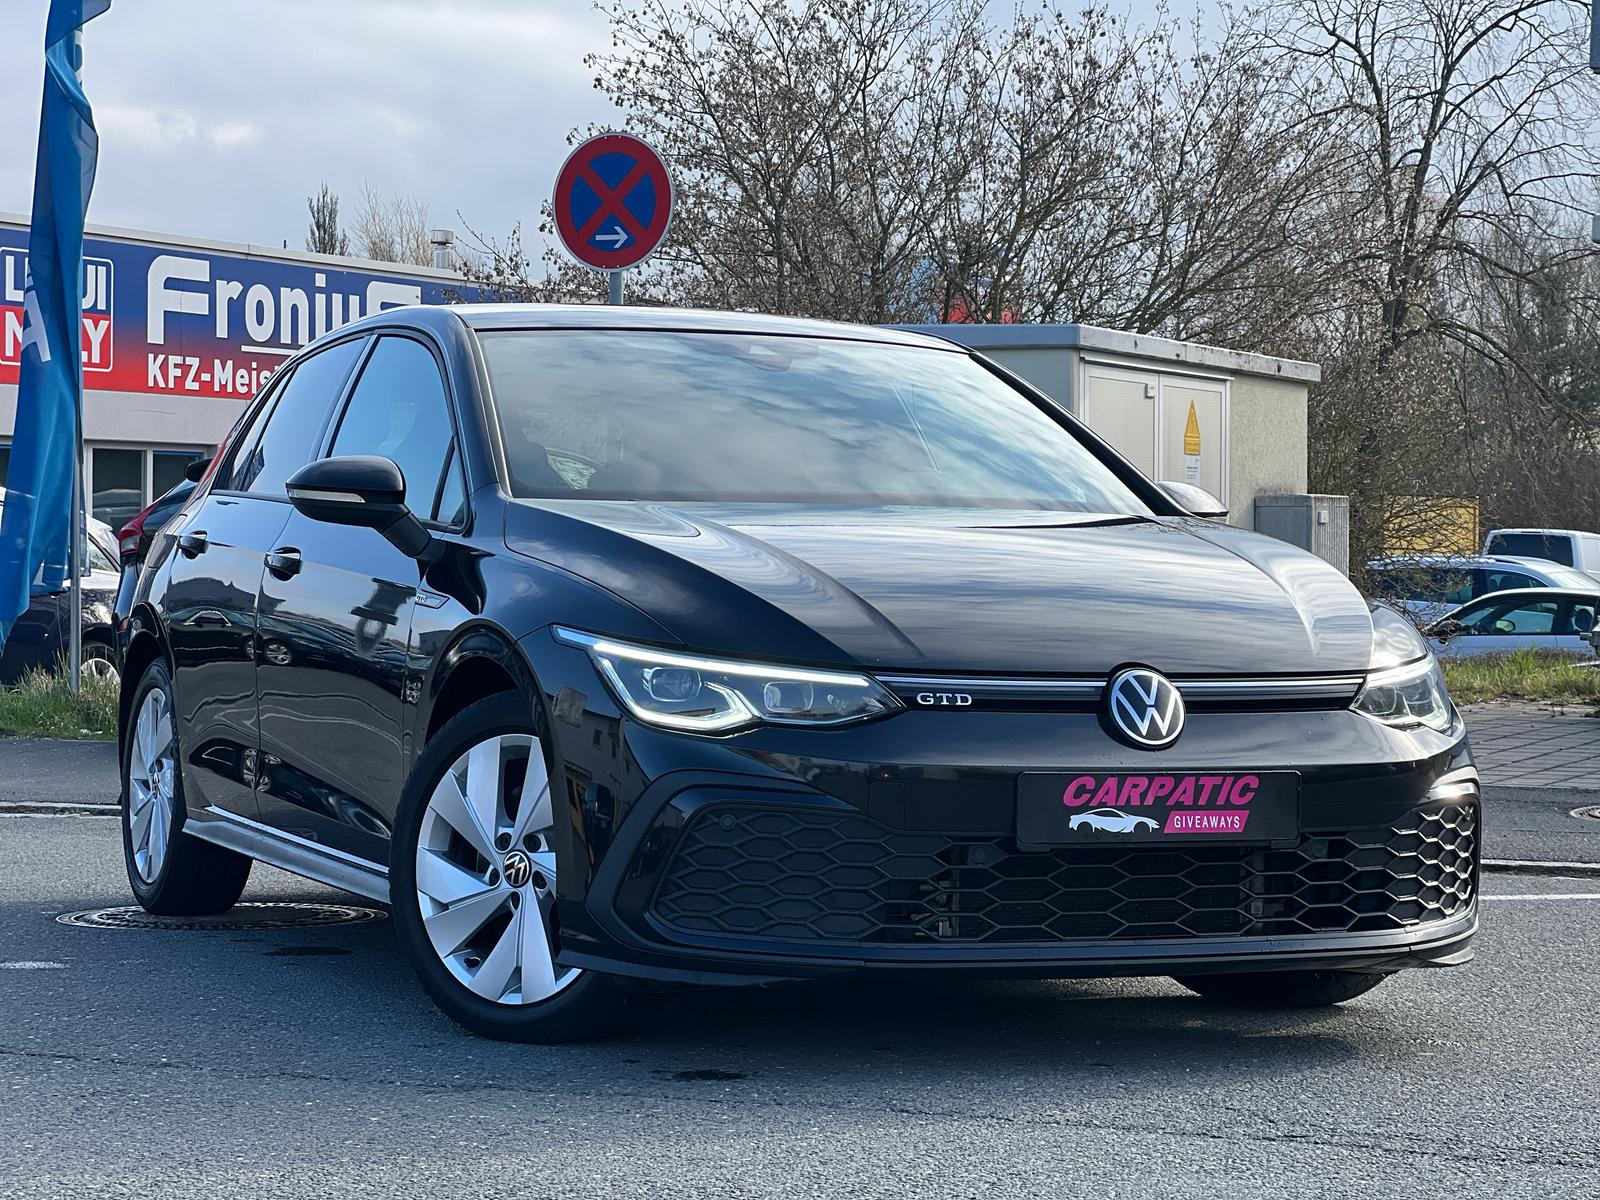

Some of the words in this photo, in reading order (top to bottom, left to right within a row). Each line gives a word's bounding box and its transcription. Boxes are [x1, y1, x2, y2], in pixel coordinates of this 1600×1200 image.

[916, 692, 972, 706] GTD
[1113, 672, 1181, 740] VW
[1063, 775, 1260, 807] CARPATIC
[1174, 815, 1240, 829] GIVEAWAYS
